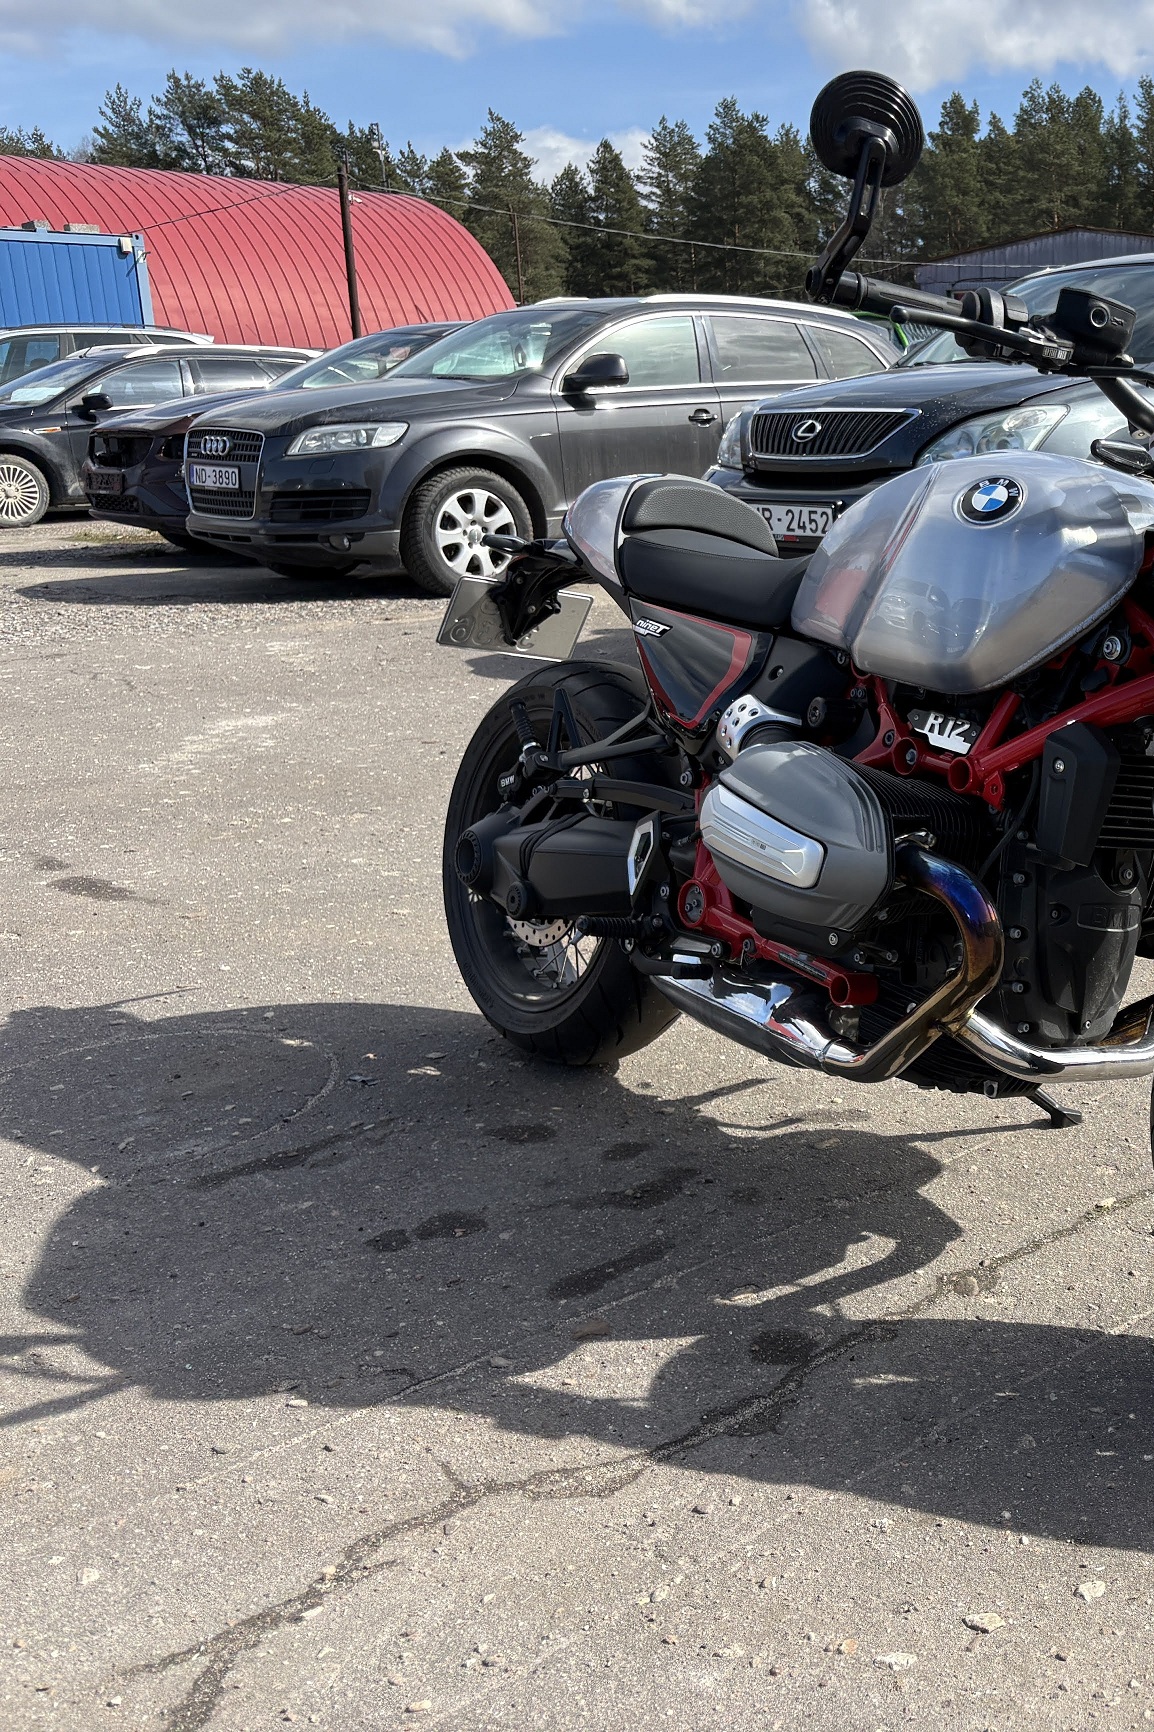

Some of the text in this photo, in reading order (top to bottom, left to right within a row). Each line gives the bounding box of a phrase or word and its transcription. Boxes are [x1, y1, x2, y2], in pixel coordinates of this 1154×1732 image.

[195, 466, 237, 487] ND-3890
[757, 507, 829, 535] R-2452
[500, 775, 515, 788] BMW
